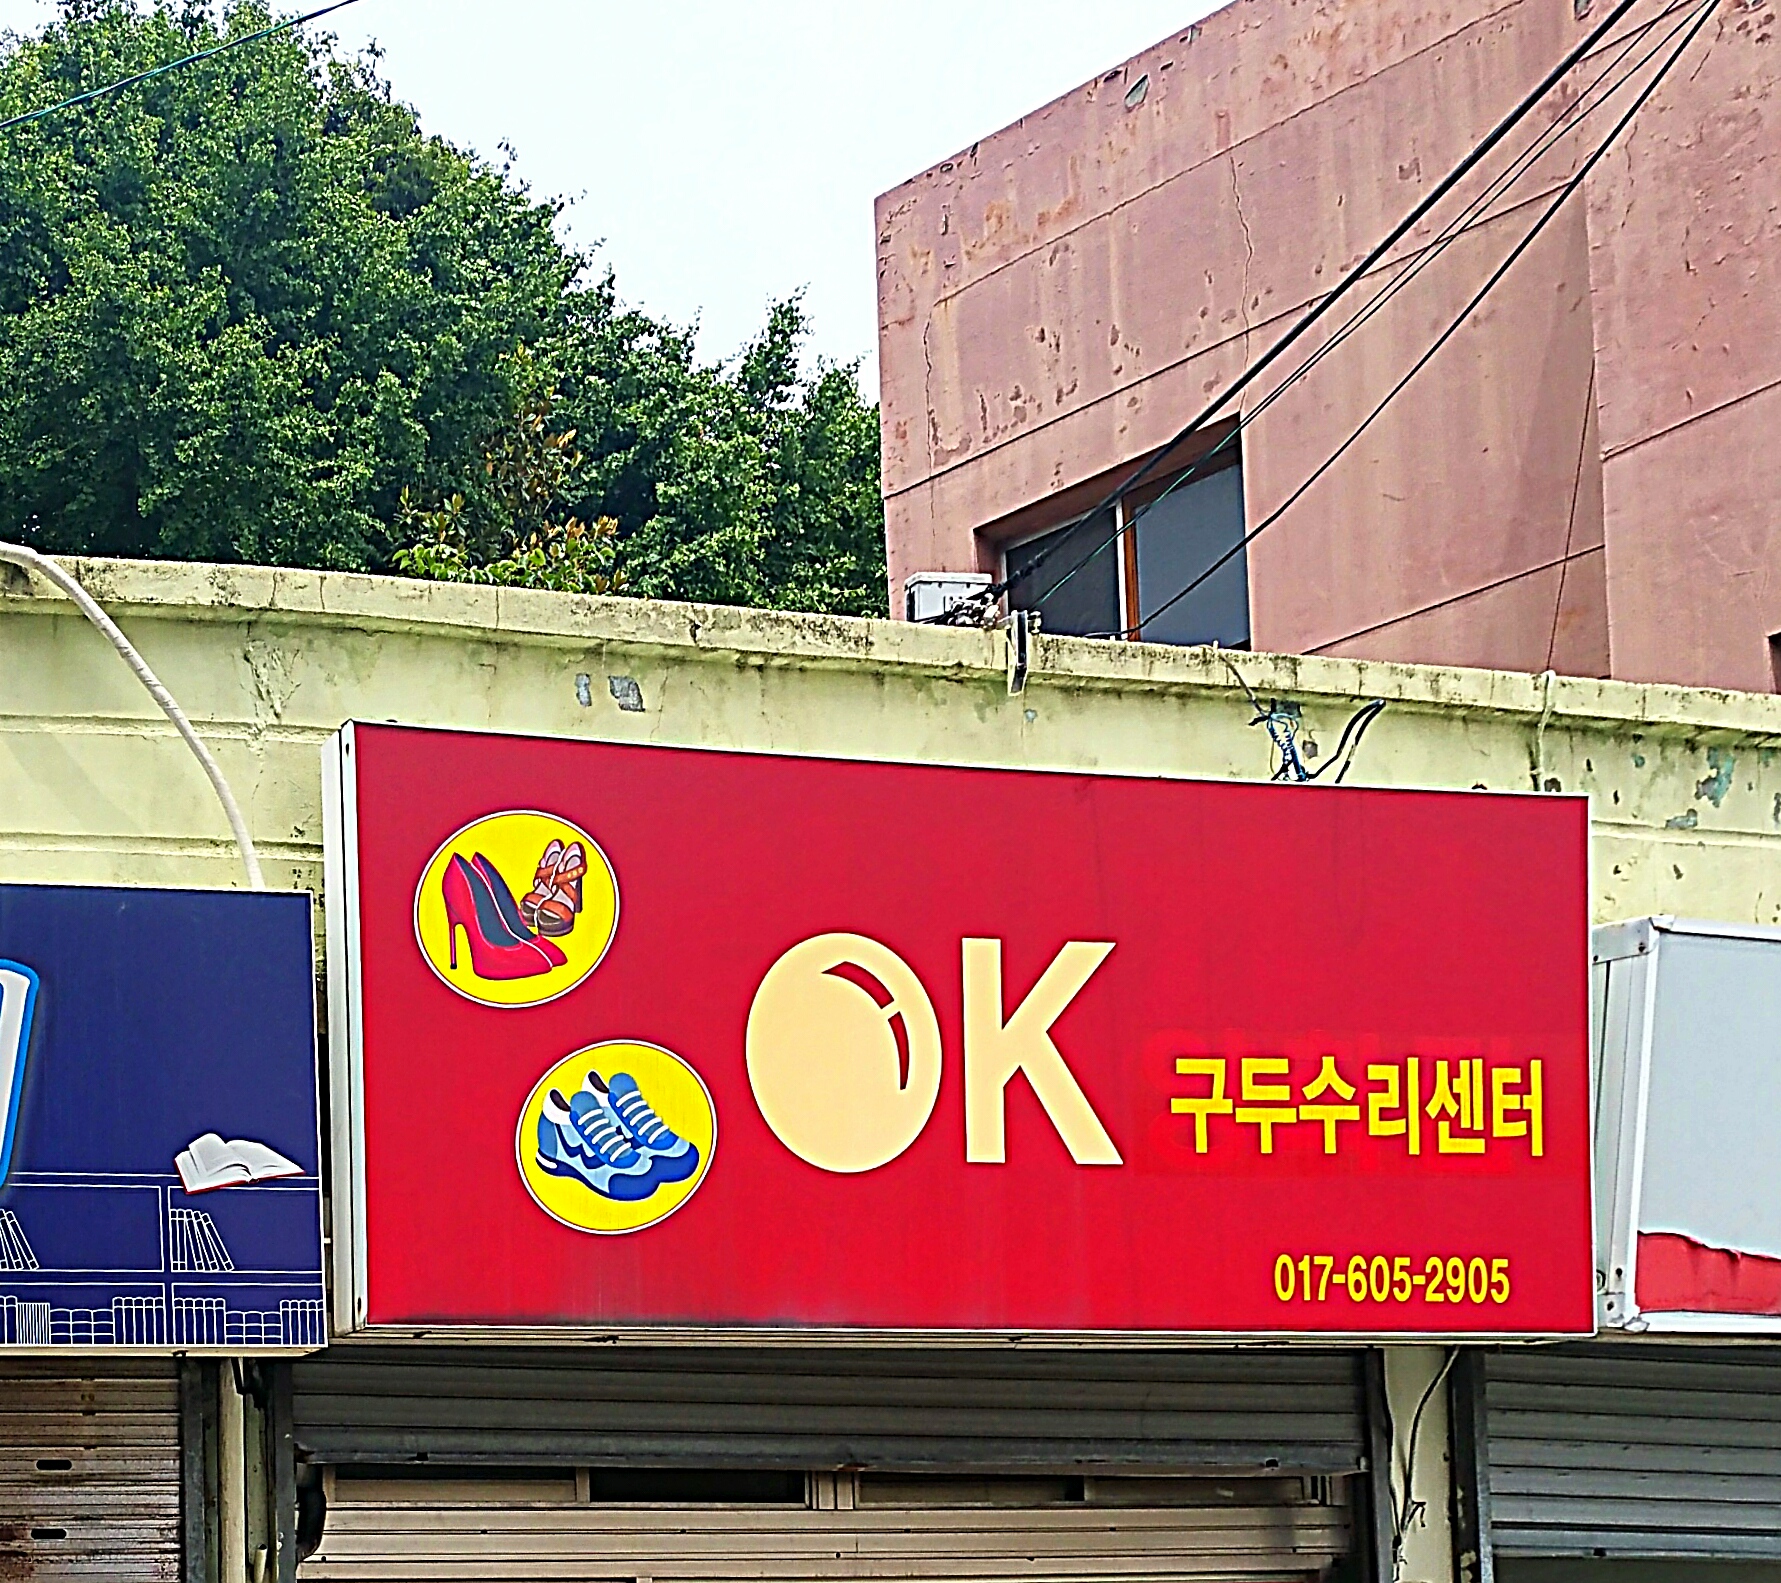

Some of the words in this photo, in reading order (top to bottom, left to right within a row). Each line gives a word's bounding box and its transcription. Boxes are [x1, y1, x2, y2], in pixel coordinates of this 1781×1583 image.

[746, 933, 1123, 1172] OK
[1170, 1056, 1543, 1157] 구두수리센터
[1274, 1254, 1510, 1304] 017-605-2905
